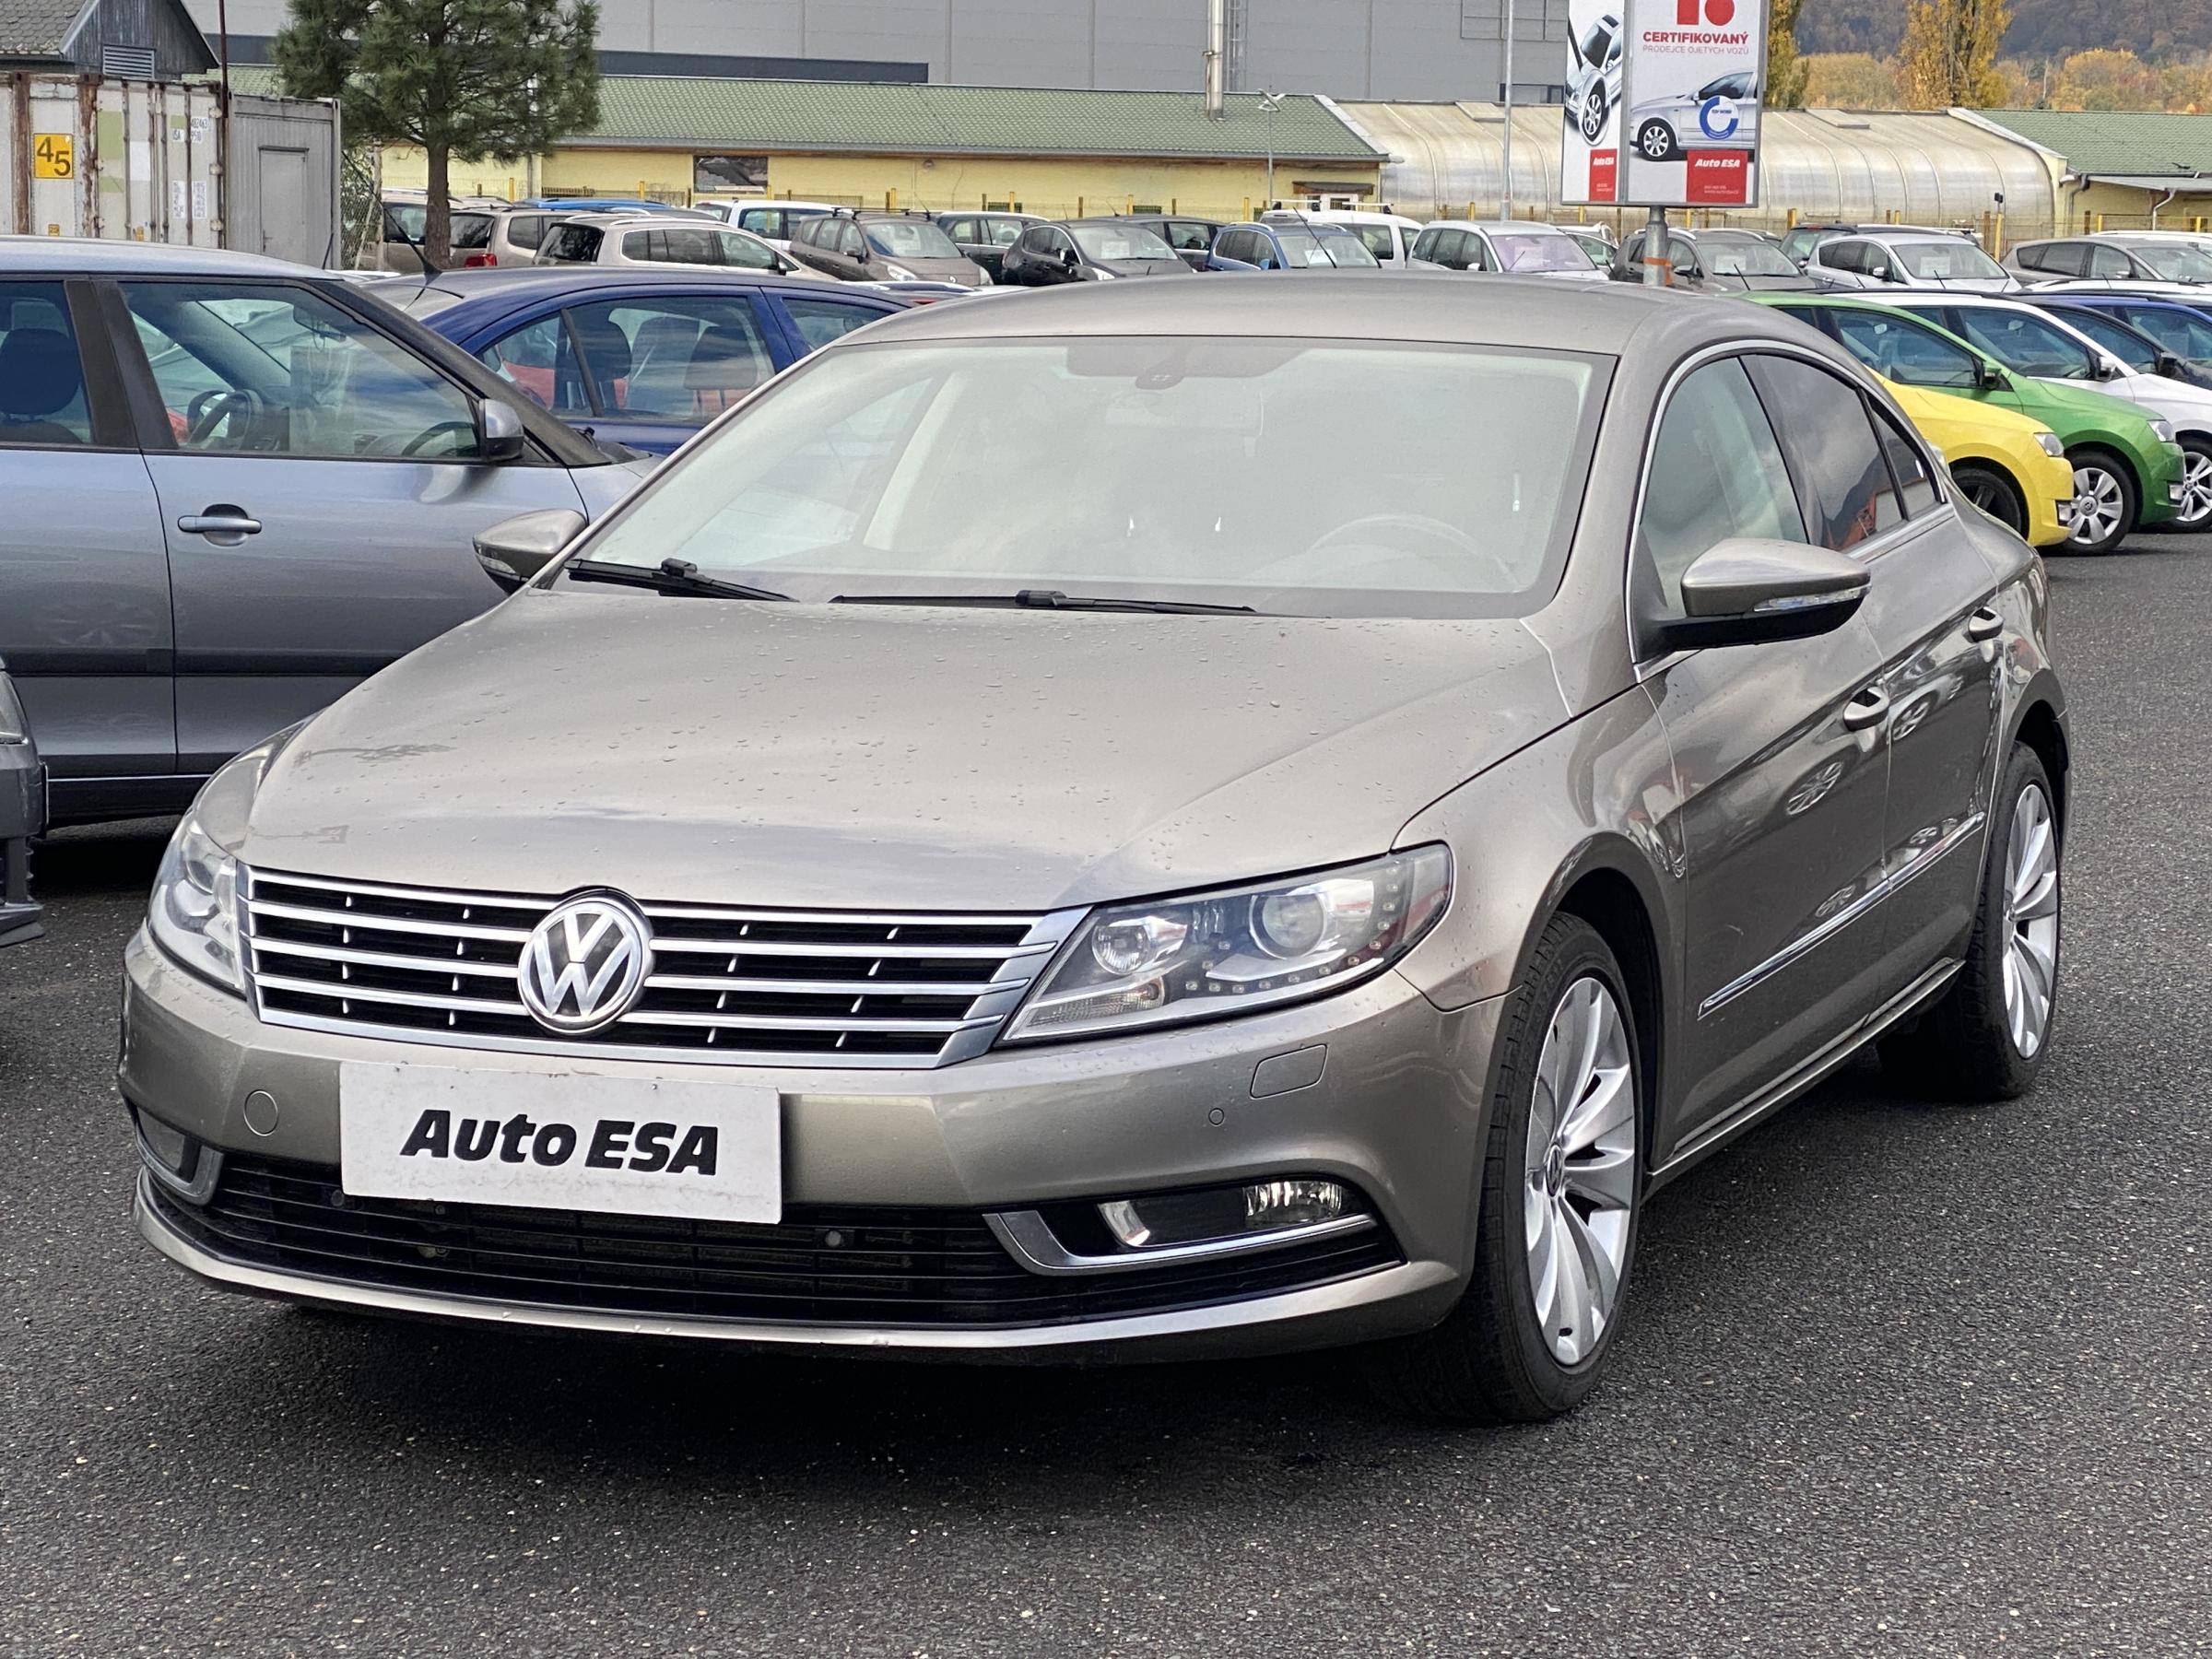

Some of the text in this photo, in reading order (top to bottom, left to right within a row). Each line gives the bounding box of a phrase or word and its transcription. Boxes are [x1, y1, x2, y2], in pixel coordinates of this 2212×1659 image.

[1642, 31, 1749, 44] CERTIFIKOVANÝ
[1642, 44, 1685, 53] PRODEJCE
[37, 136, 71, 176] 45
[1695, 159, 1741, 168] Auto ESA
[529, 909, 634, 1018] VW
[399, 1109, 719, 1176] Auto ESA
